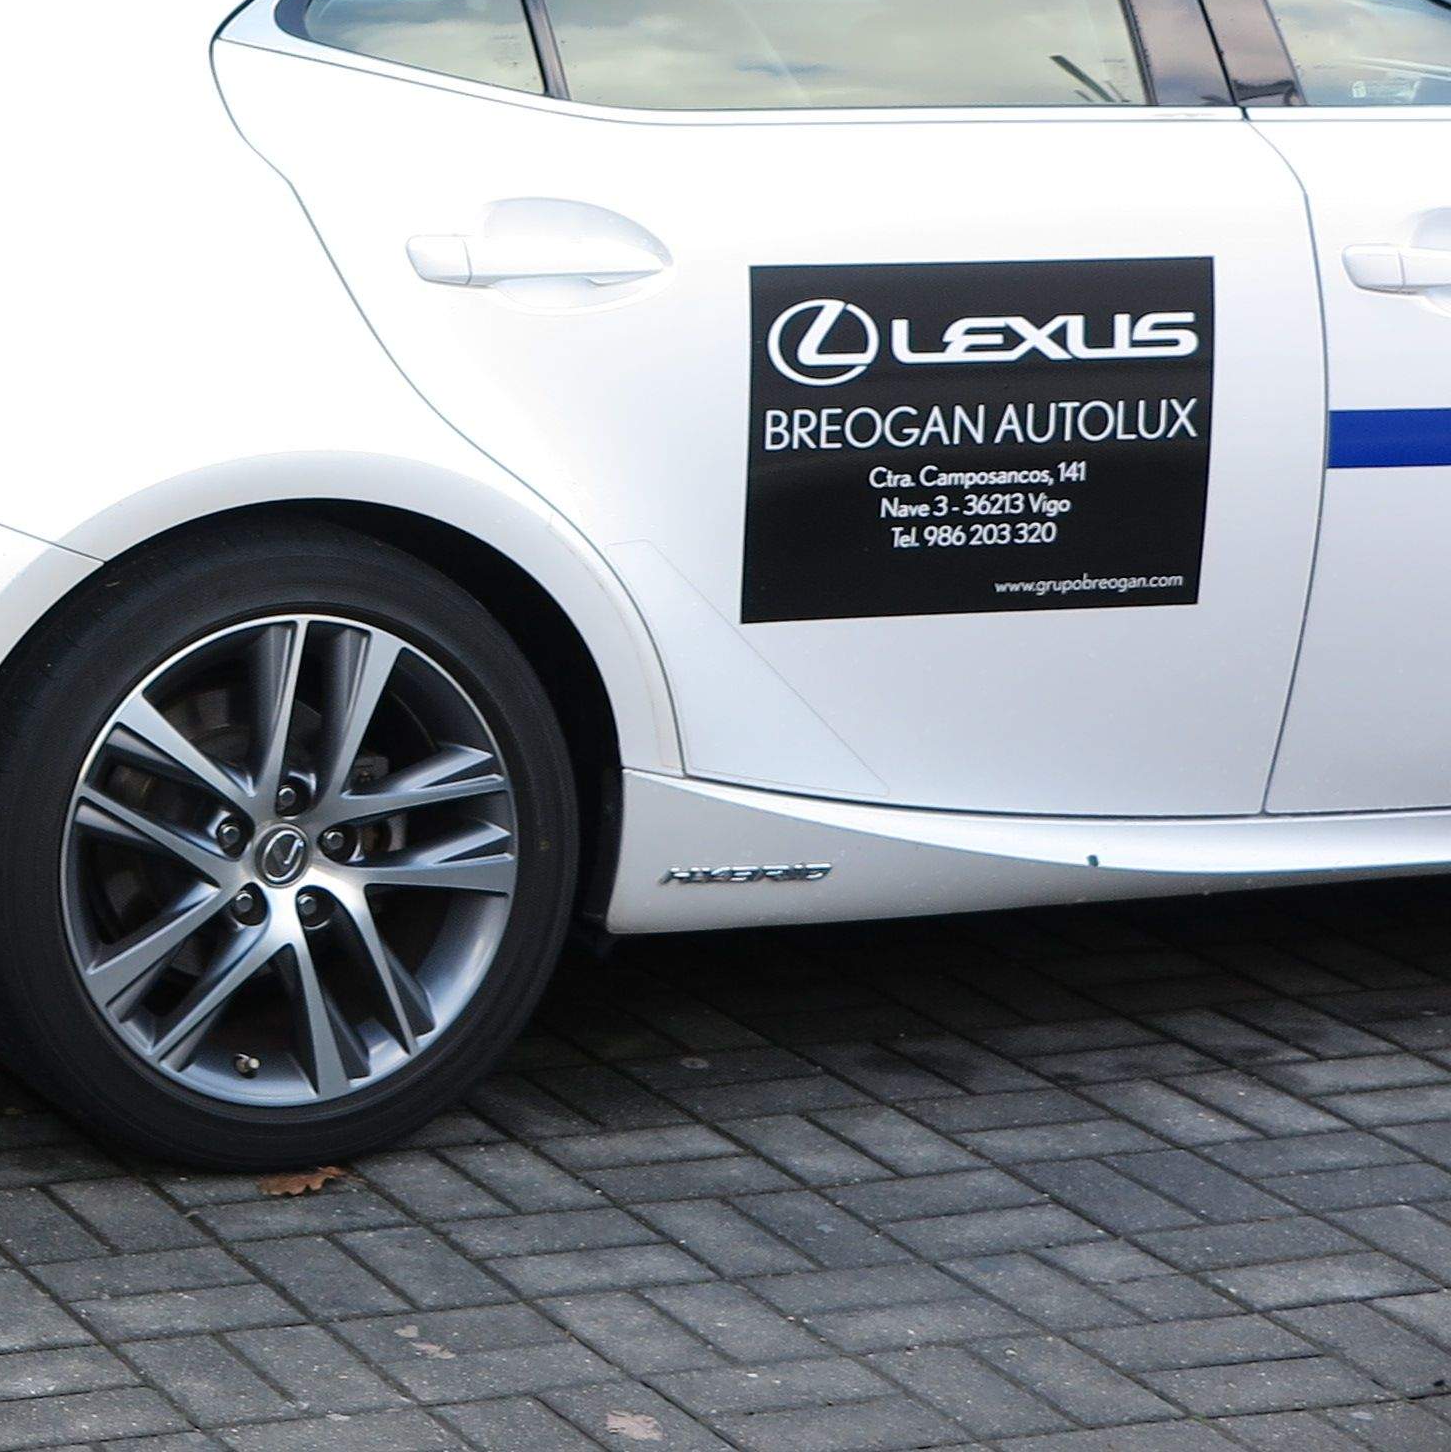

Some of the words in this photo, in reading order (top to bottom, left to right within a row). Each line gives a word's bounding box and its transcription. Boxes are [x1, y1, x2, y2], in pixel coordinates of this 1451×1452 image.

[891, 311, 1200, 365] LEXUS
[765, 405, 986, 451] BREOGAN
[994, 398, 1198, 444] AUTOLUX
[869, 466, 916, 488] Ctra.
[919, 464, 1054, 489] Camposancos,
[1057, 460, 1087, 482] 141
[880, 497, 931, 518] Nave
[933, 495, 949, 517] 3
[963, 492, 1025, 515] 36213
[1028, 491, 1072, 517] Vigo
[923, 524, 967, 547] 986
[969, 523, 1013, 546] 203
[1014, 521, 1057, 544] 320
[994, 573, 1184, 596] www.grupobreogan.com
